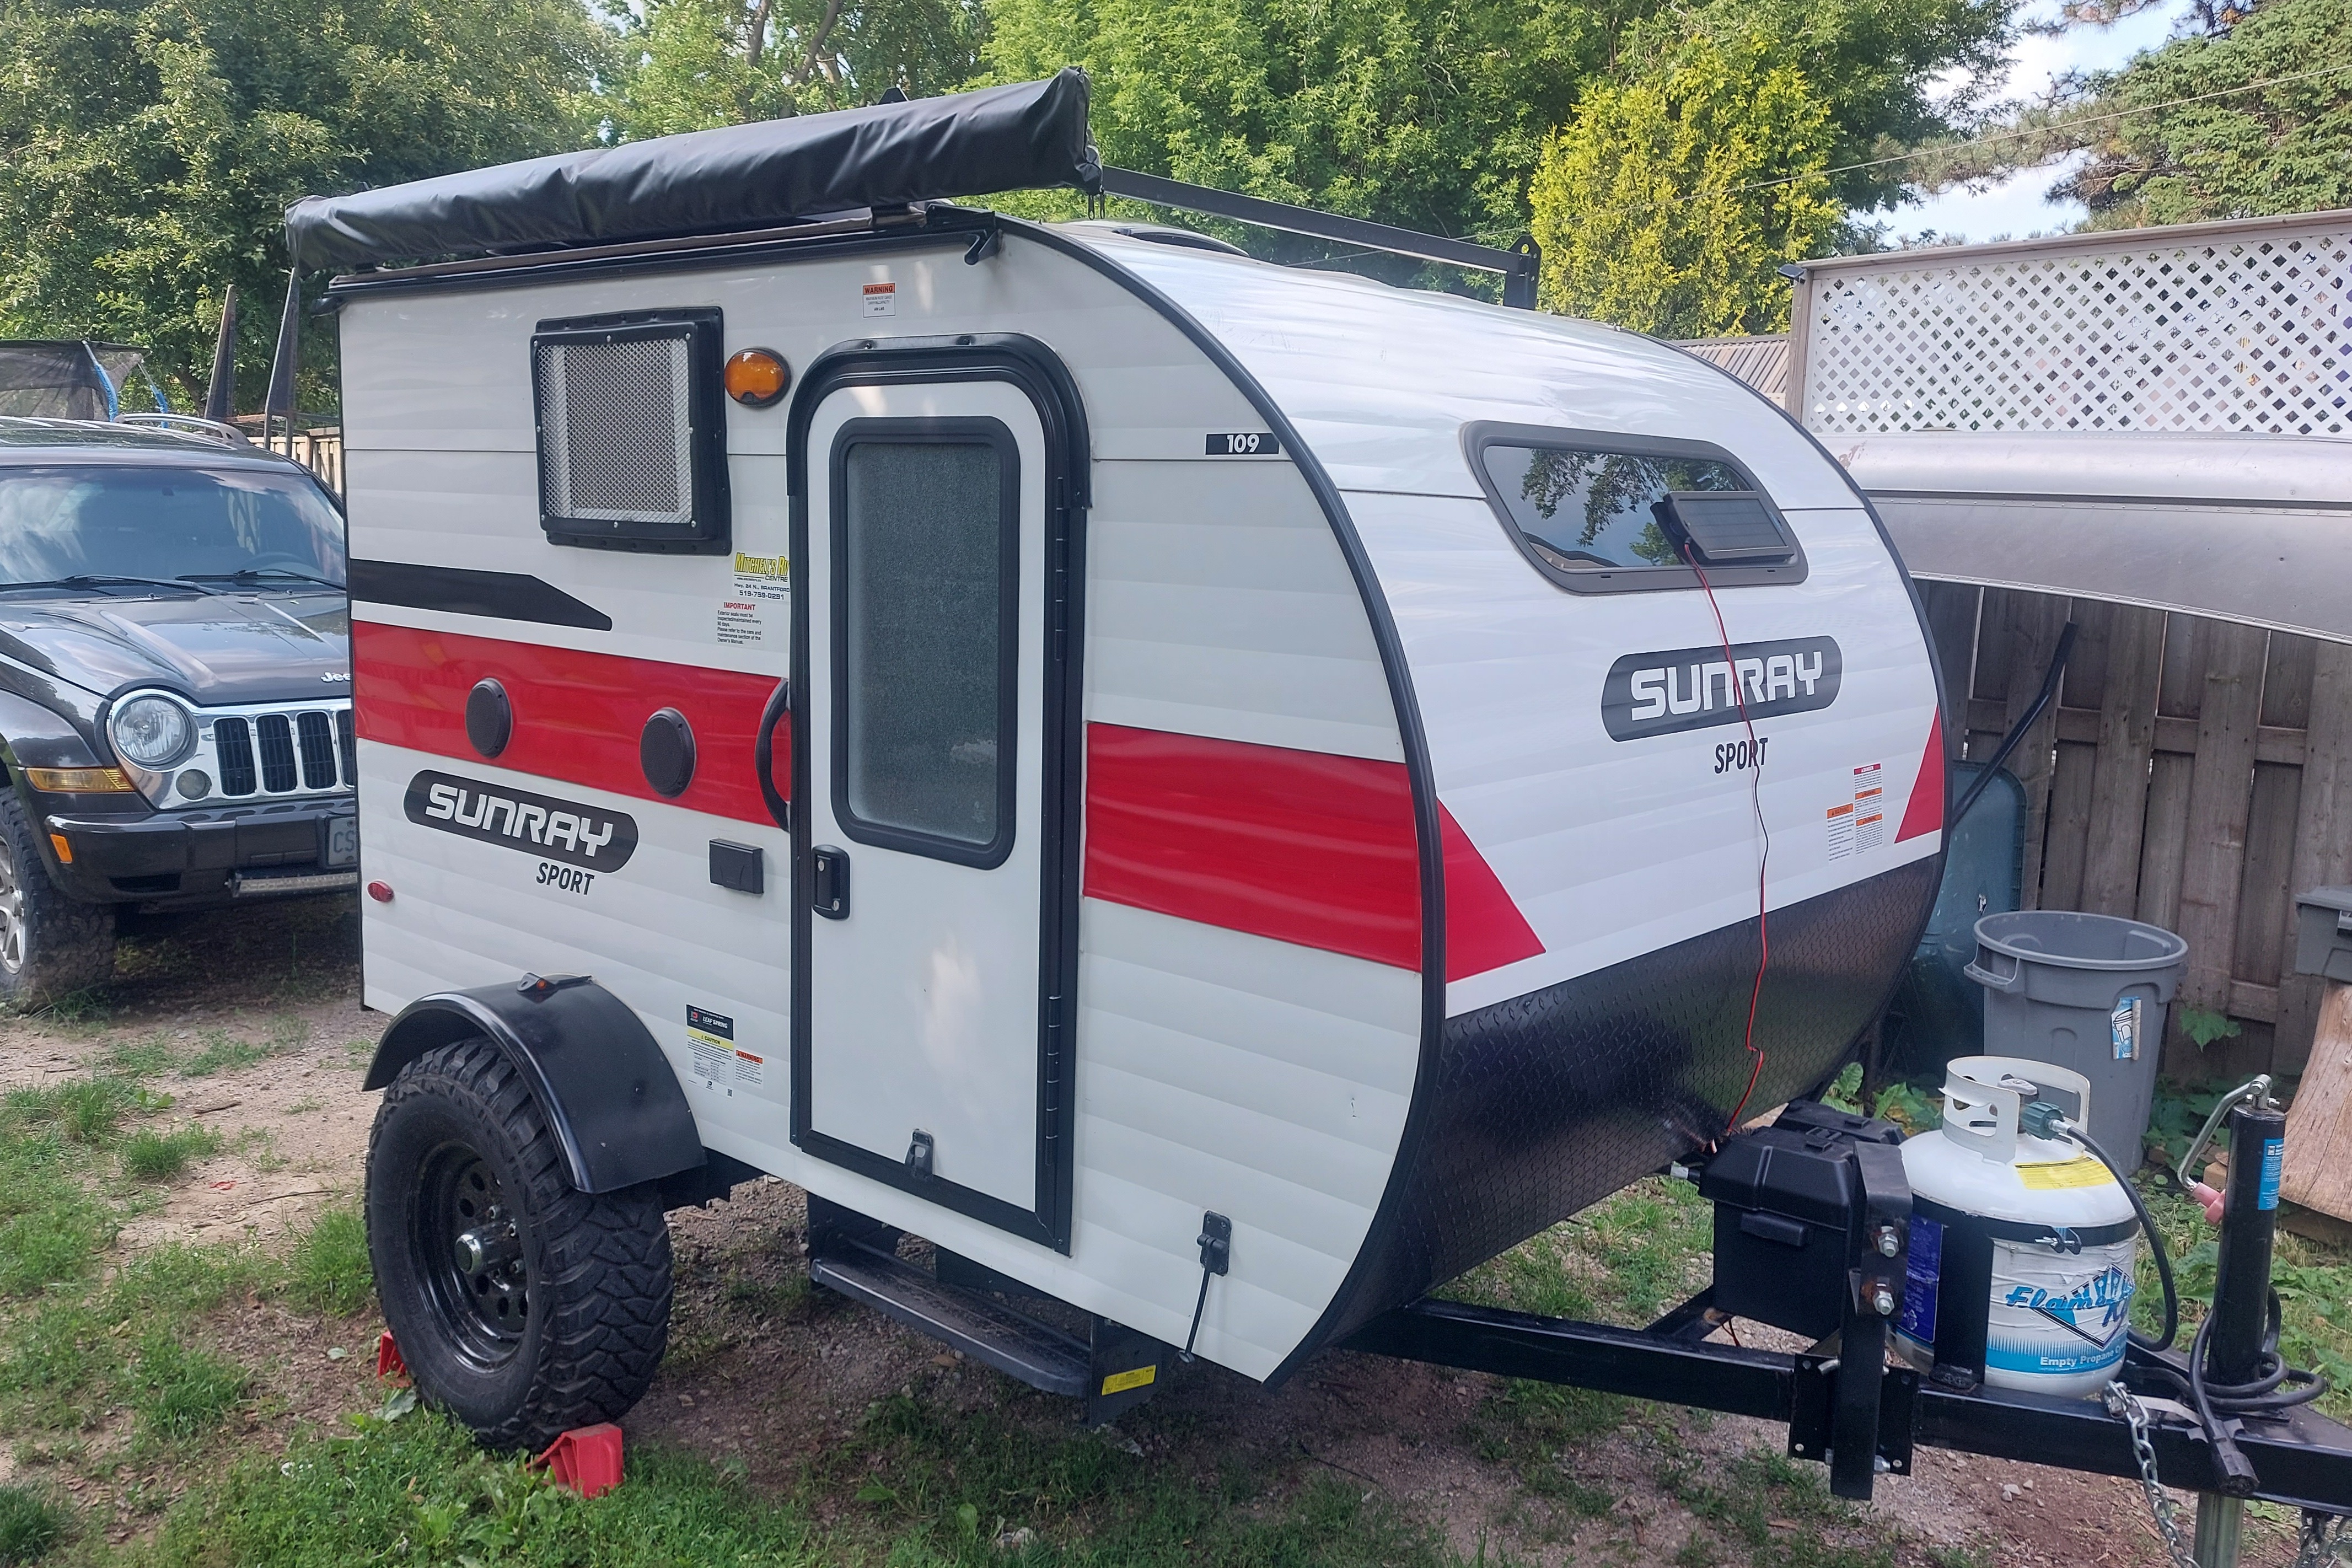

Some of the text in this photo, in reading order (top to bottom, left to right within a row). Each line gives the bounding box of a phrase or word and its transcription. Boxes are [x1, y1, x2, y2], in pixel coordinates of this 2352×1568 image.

[1227, 434, 1260, 453] 109
[723, 602, 756, 610] IMPORTANT
[320, 672, 351, 683] Jee
[1630, 651, 1823, 722] SUNRAY
[1714, 737, 1769, 774] SPORT
[425, 783, 614, 858] SUNRAY
[333, 830, 355, 853] CS
[536, 861, 596, 896] SPORT
[704, 1035, 721, 1045] CAUTION
[2005, 1286, 2107, 1311] Flame
[2040, 1356, 2077, 1368] Empty
[2080, 1350, 2114, 1366] Propane
